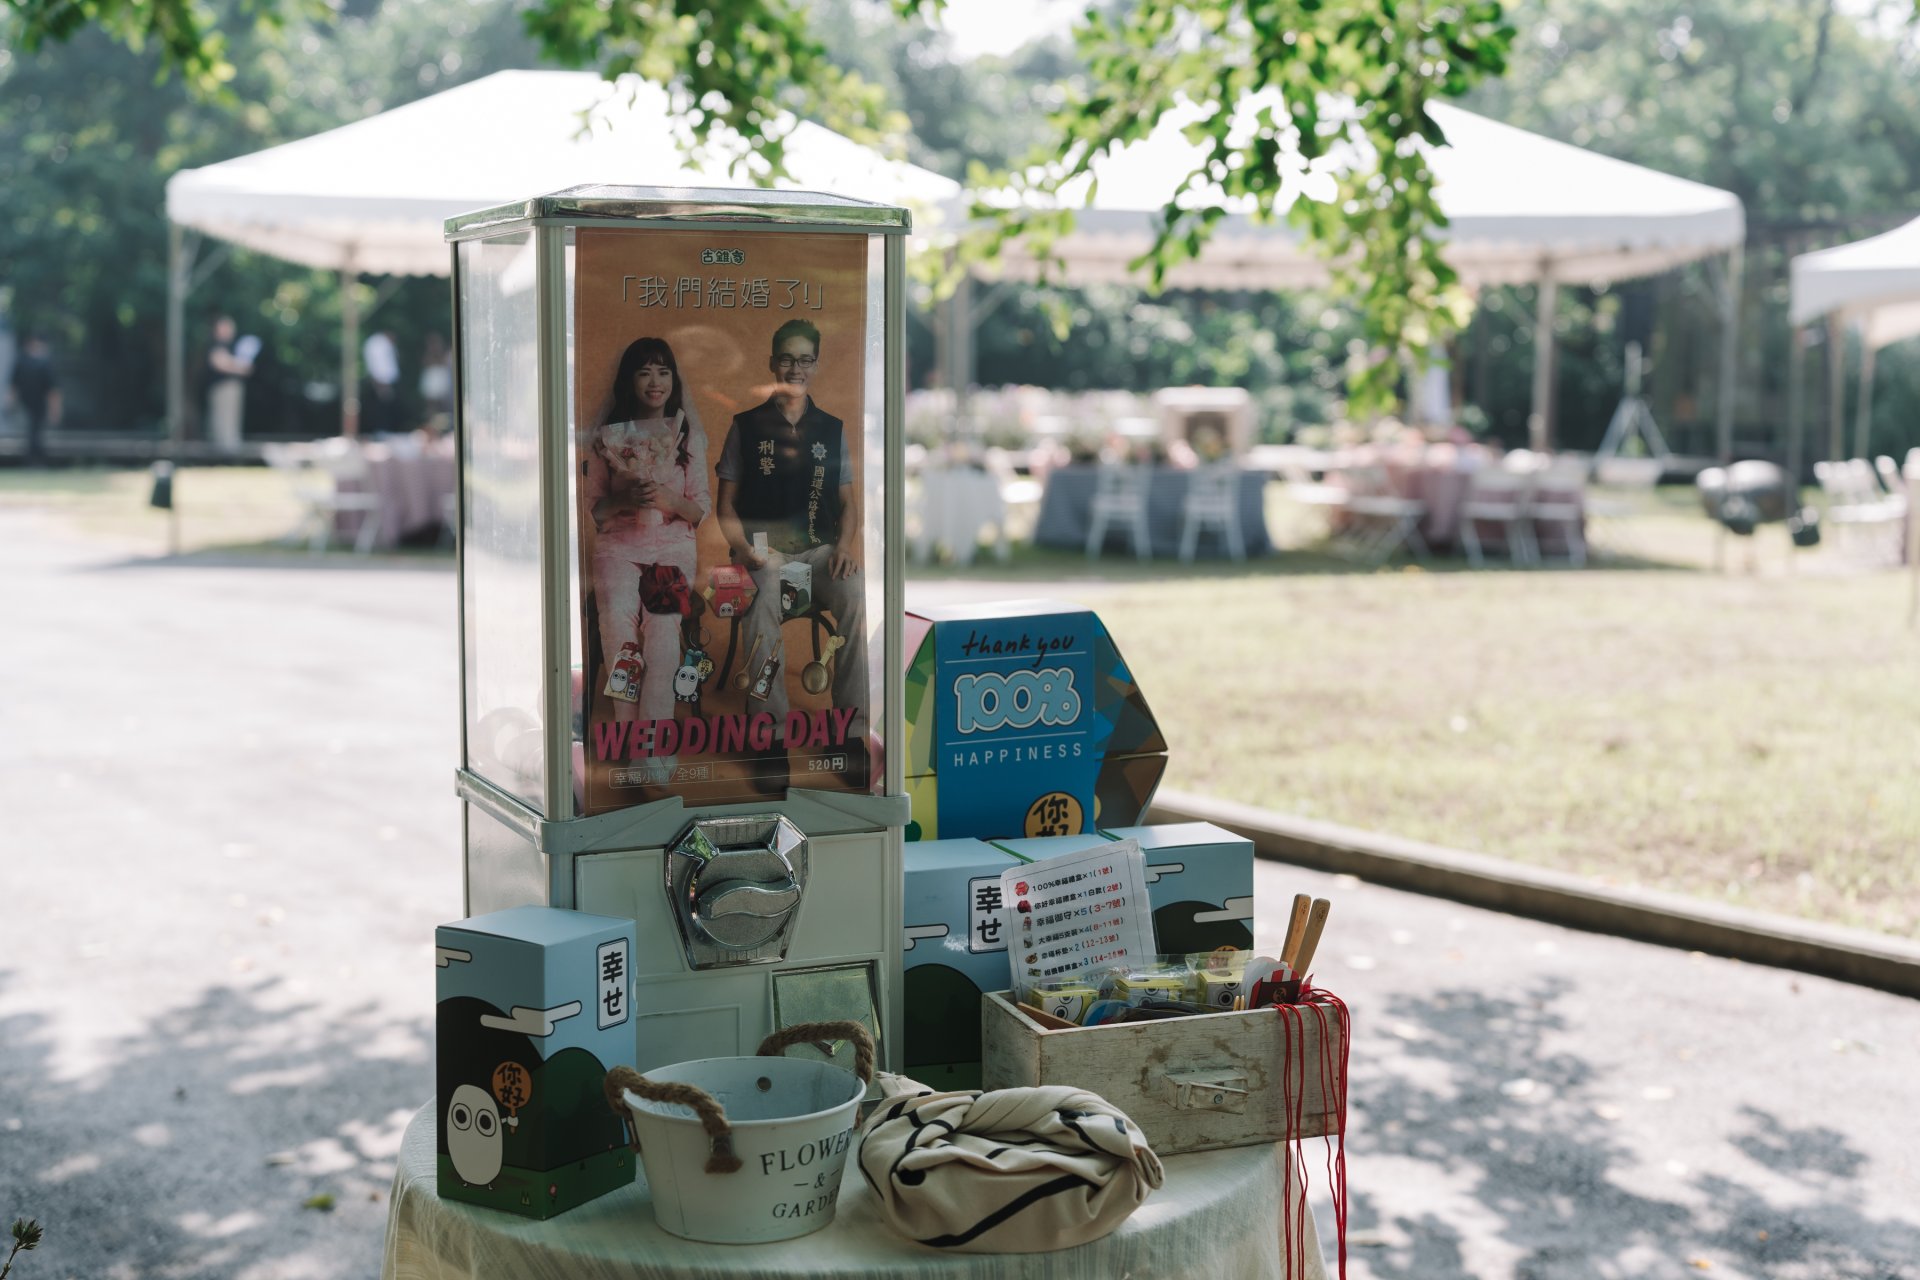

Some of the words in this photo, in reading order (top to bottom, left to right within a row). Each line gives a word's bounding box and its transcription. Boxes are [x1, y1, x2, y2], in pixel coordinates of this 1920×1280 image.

[758, 440, 775, 475] 刑警
[962, 630, 1030, 656] thank
[1032, 635, 1074, 667] you
[954, 667, 1081, 734] 100%
[594, 712, 776, 761] WEDDING
[783, 708, 858, 750] DAY
[954, 743, 1082, 767] HAPPINESS
[808, 757, 844, 771] 520円
[976, 886, 1002, 943] 幸せ
[602, 951, 623, 1017] 幸せ
[497, 1066, 525, 1107] 你好
